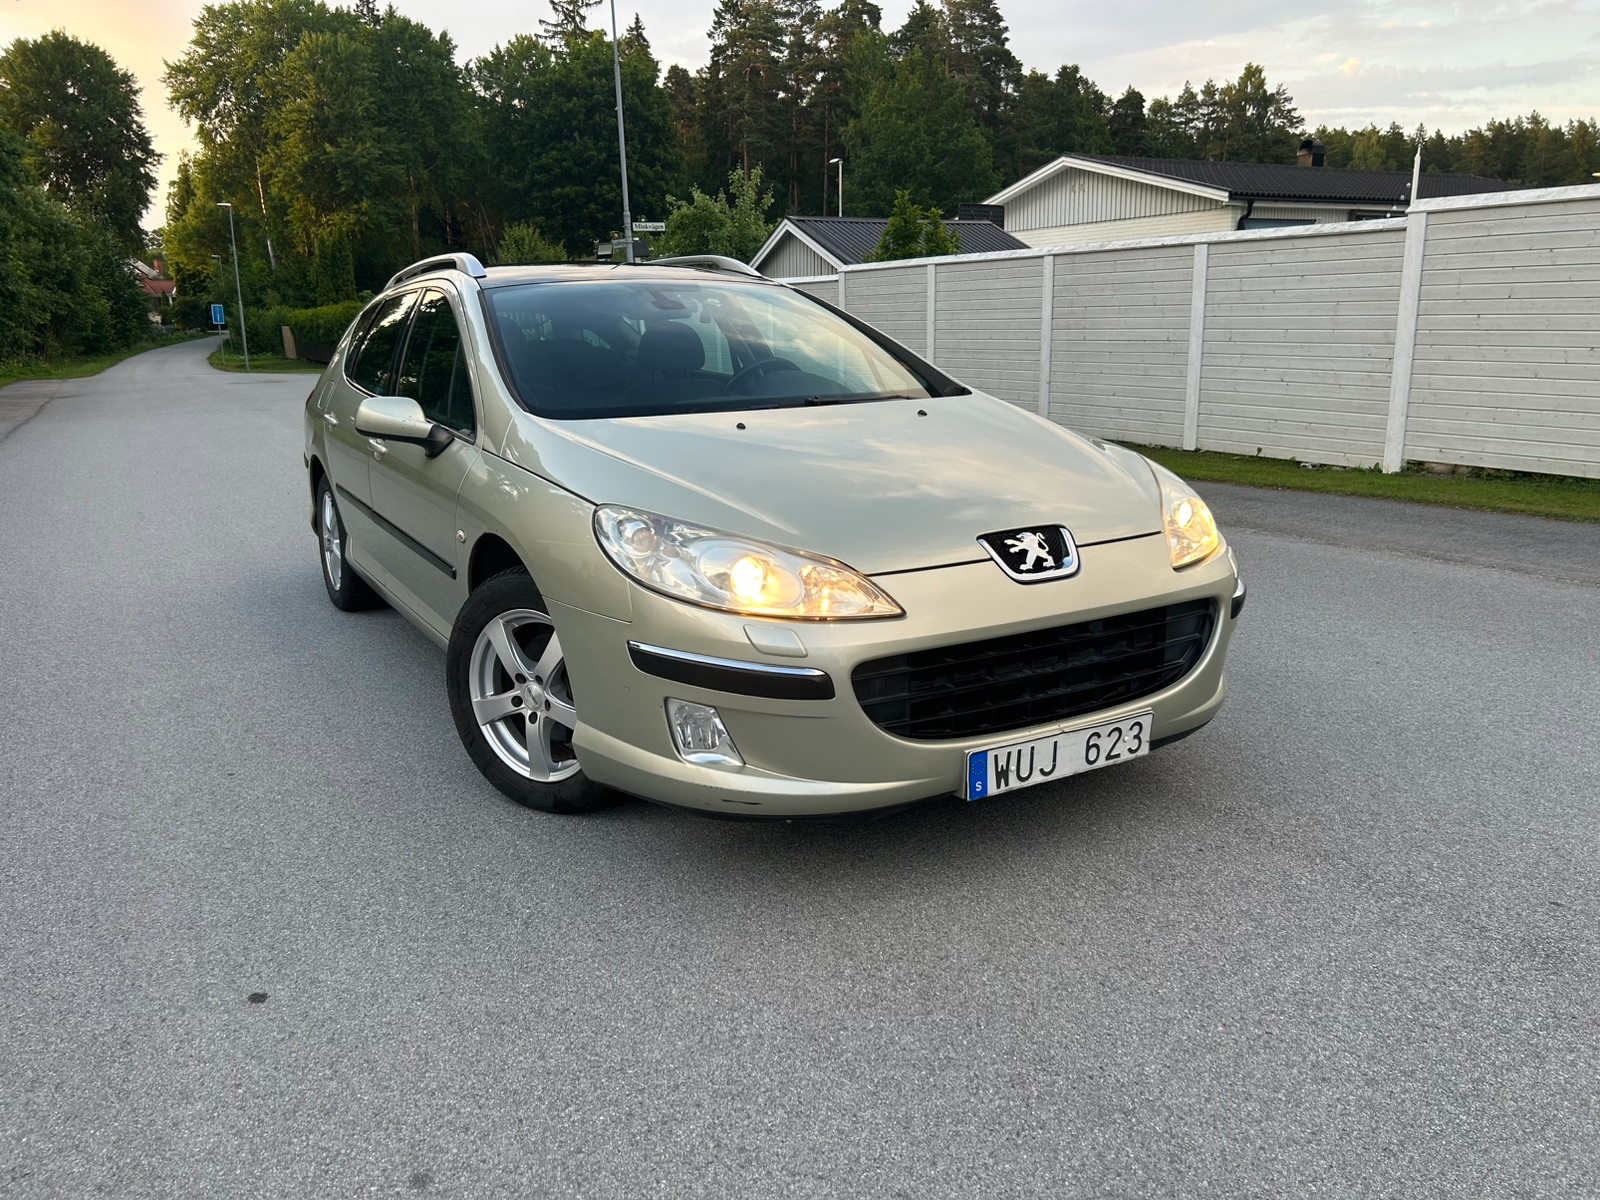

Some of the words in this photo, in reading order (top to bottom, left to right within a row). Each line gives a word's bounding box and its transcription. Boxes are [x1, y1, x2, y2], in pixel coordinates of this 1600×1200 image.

[634, 223, 664, 231] Minkvägen
[994, 740, 1058, 789] WUJ
[1085, 721, 1143, 765] 623
[975, 781, 982, 792] S
